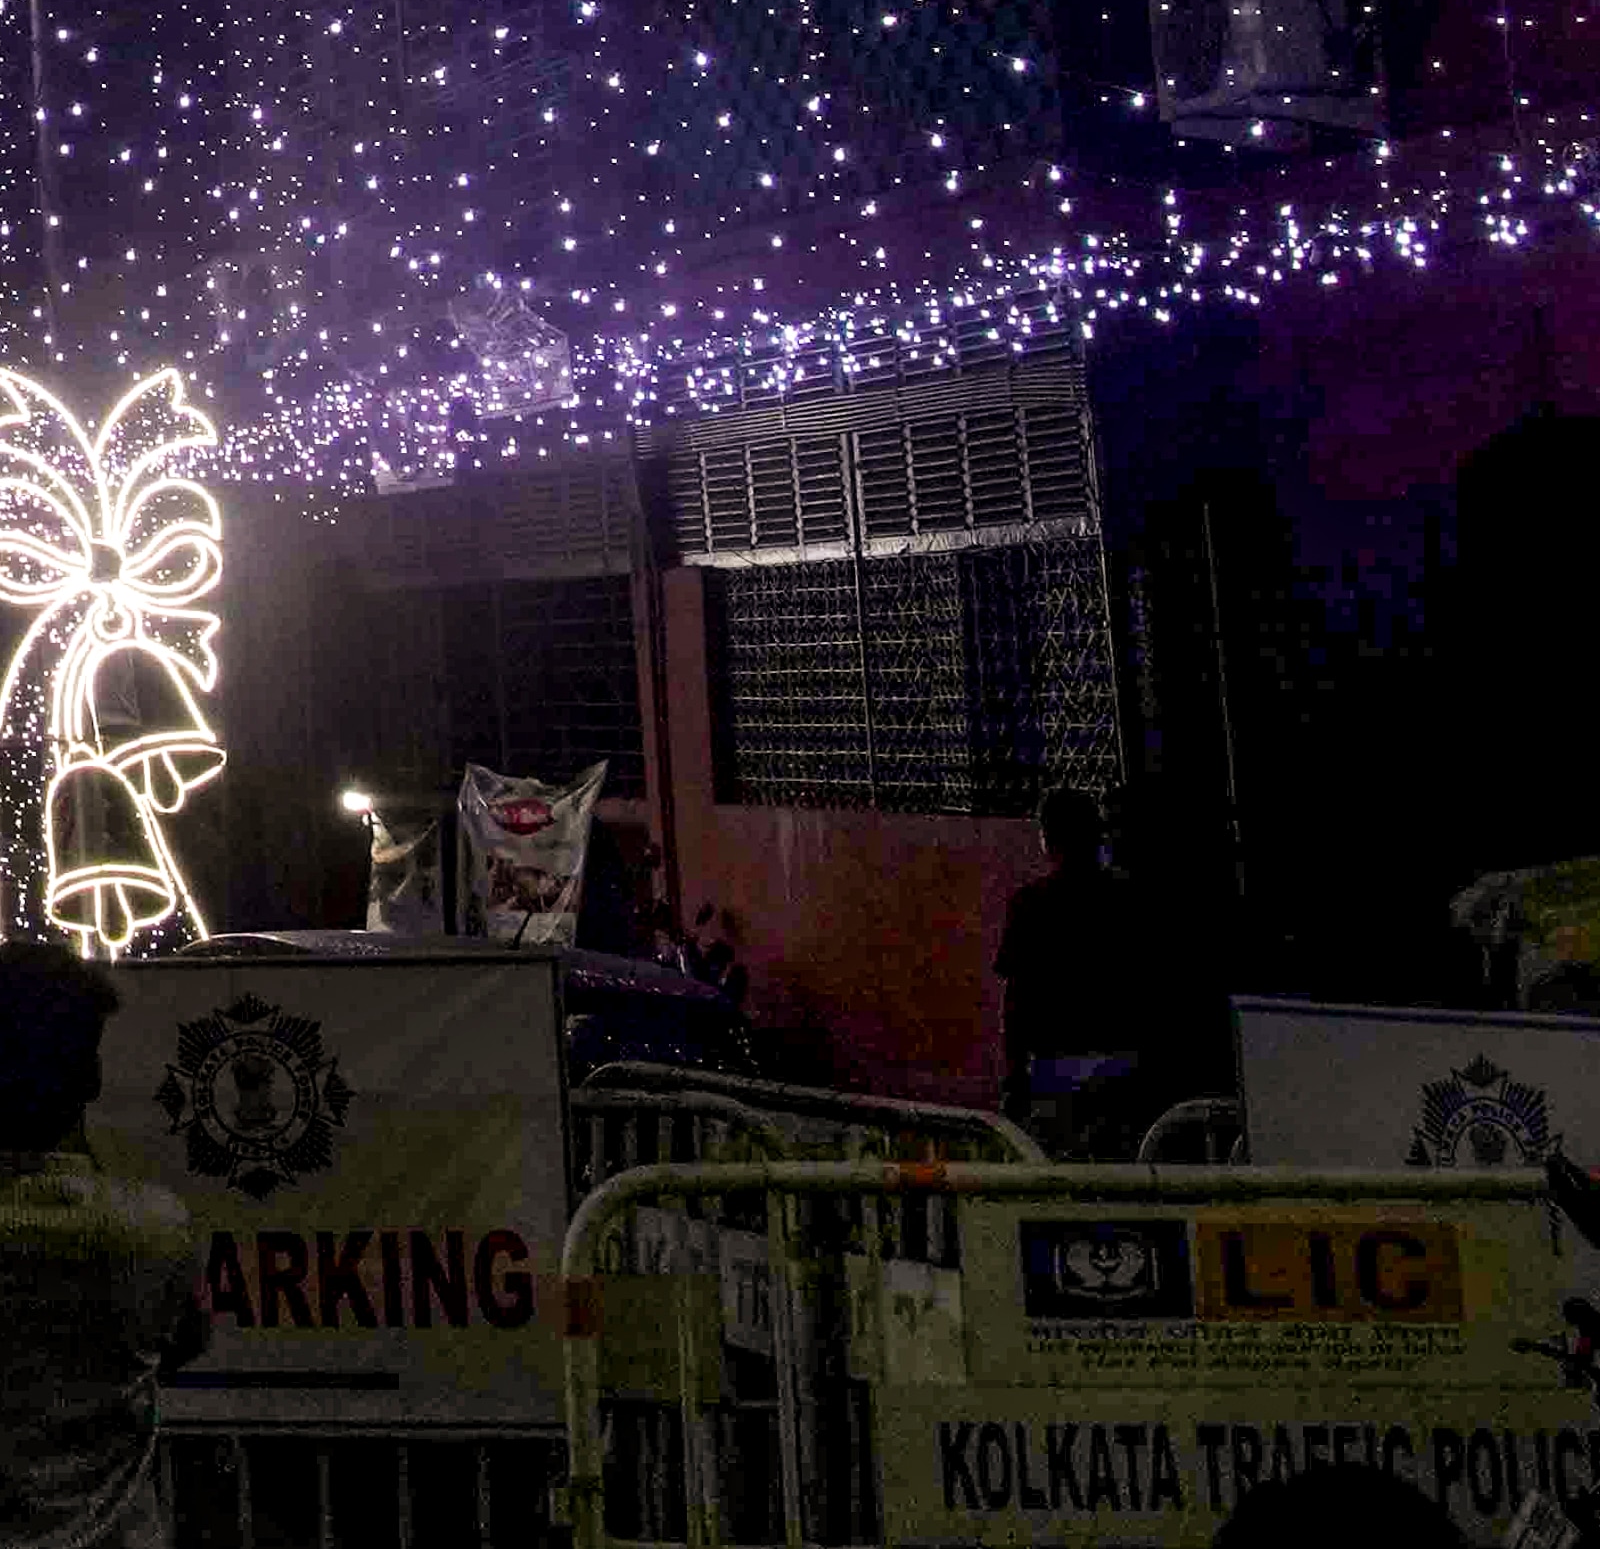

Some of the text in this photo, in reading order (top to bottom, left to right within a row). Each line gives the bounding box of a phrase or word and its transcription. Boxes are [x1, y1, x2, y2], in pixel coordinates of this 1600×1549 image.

[206, 1229, 535, 1329] ARKING
[1220, 1230, 1431, 1309] LIC
[940, 1421, 1185, 1512] KOLKATA
